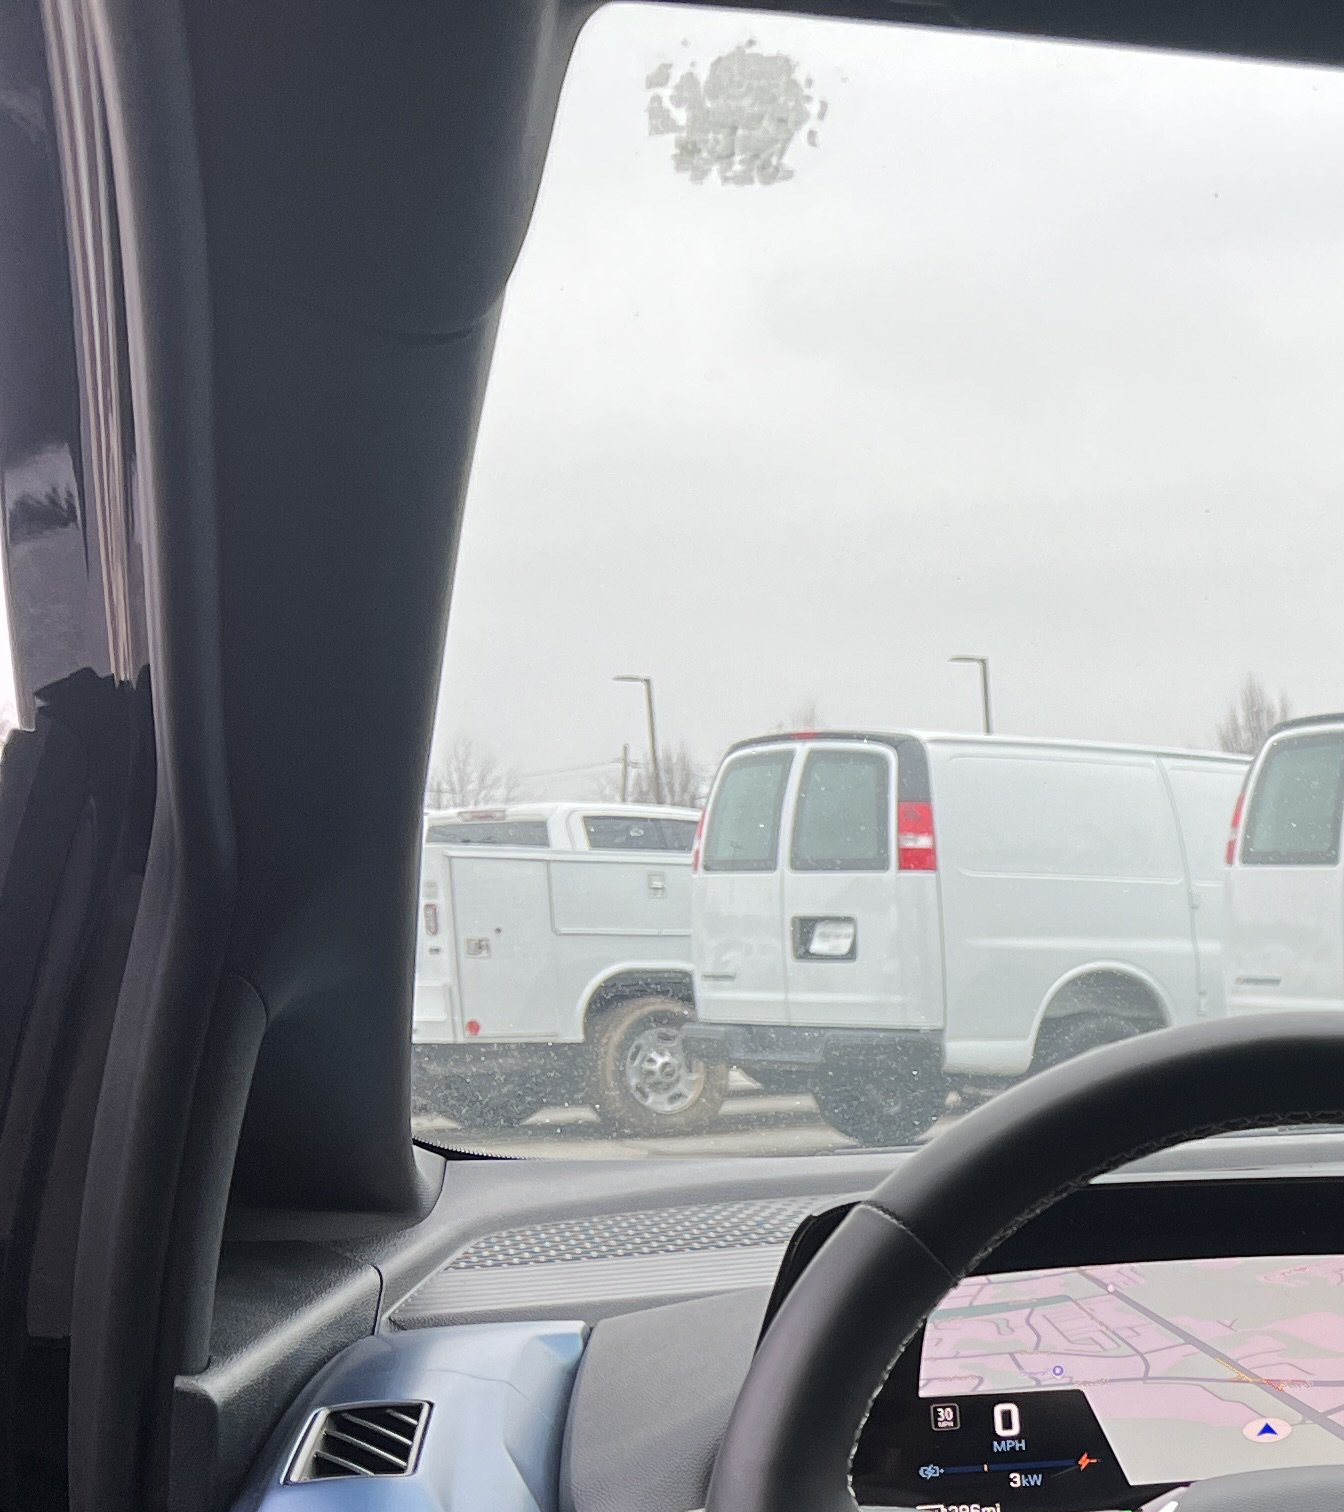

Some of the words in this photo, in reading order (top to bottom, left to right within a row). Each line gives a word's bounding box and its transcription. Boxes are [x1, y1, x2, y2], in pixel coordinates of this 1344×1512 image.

[936, 1407, 954, 1421] 30
[994, 1403, 1020, 1437] 0
[992, 1439, 1026, 1452] MPH
